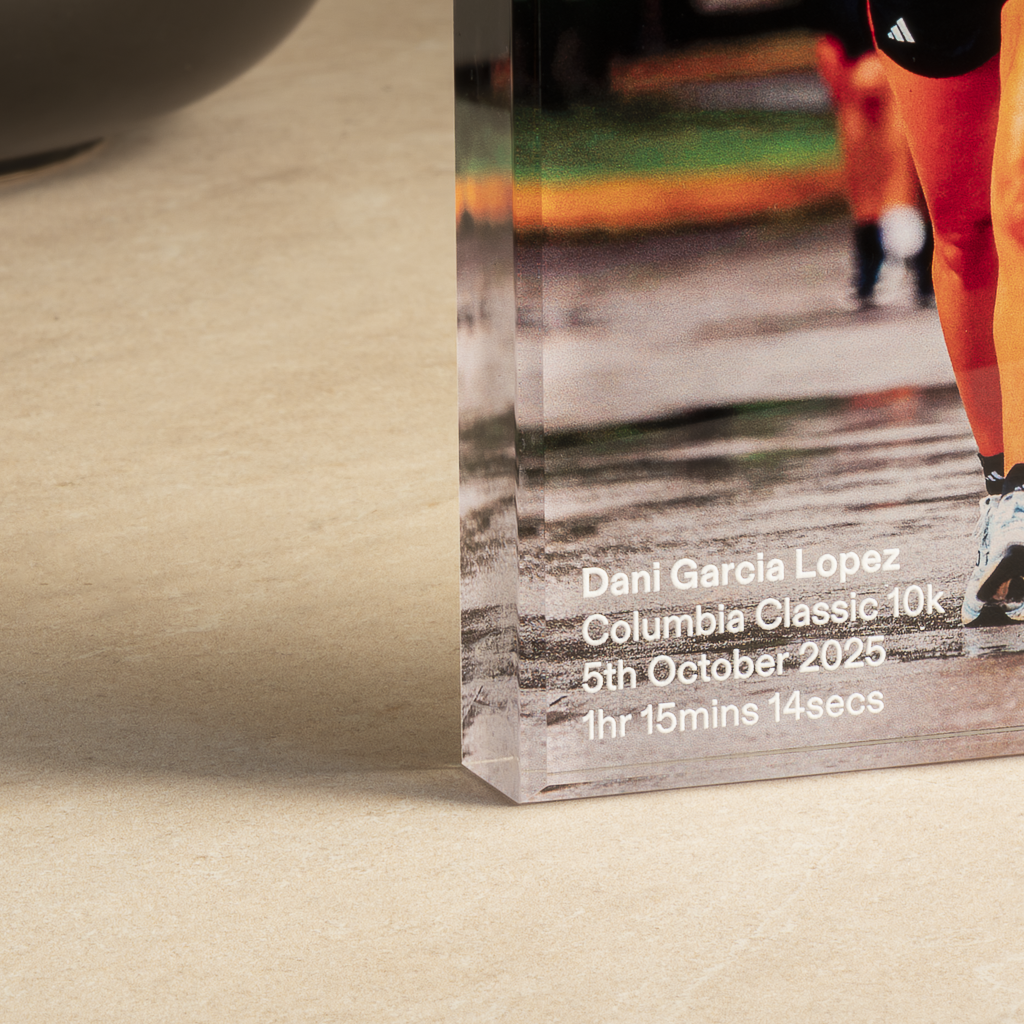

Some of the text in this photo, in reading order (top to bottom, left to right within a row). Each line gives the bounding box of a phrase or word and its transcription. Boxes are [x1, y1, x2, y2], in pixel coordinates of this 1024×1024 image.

[582, 547, 901, 598] Dani Garcia Lopez
[582, 583, 947, 647] Columbia Classic 10k
[582, 635, 887, 694] 5th October 2025
[582, 689, 886, 741] 1hr 15mins 14secs
